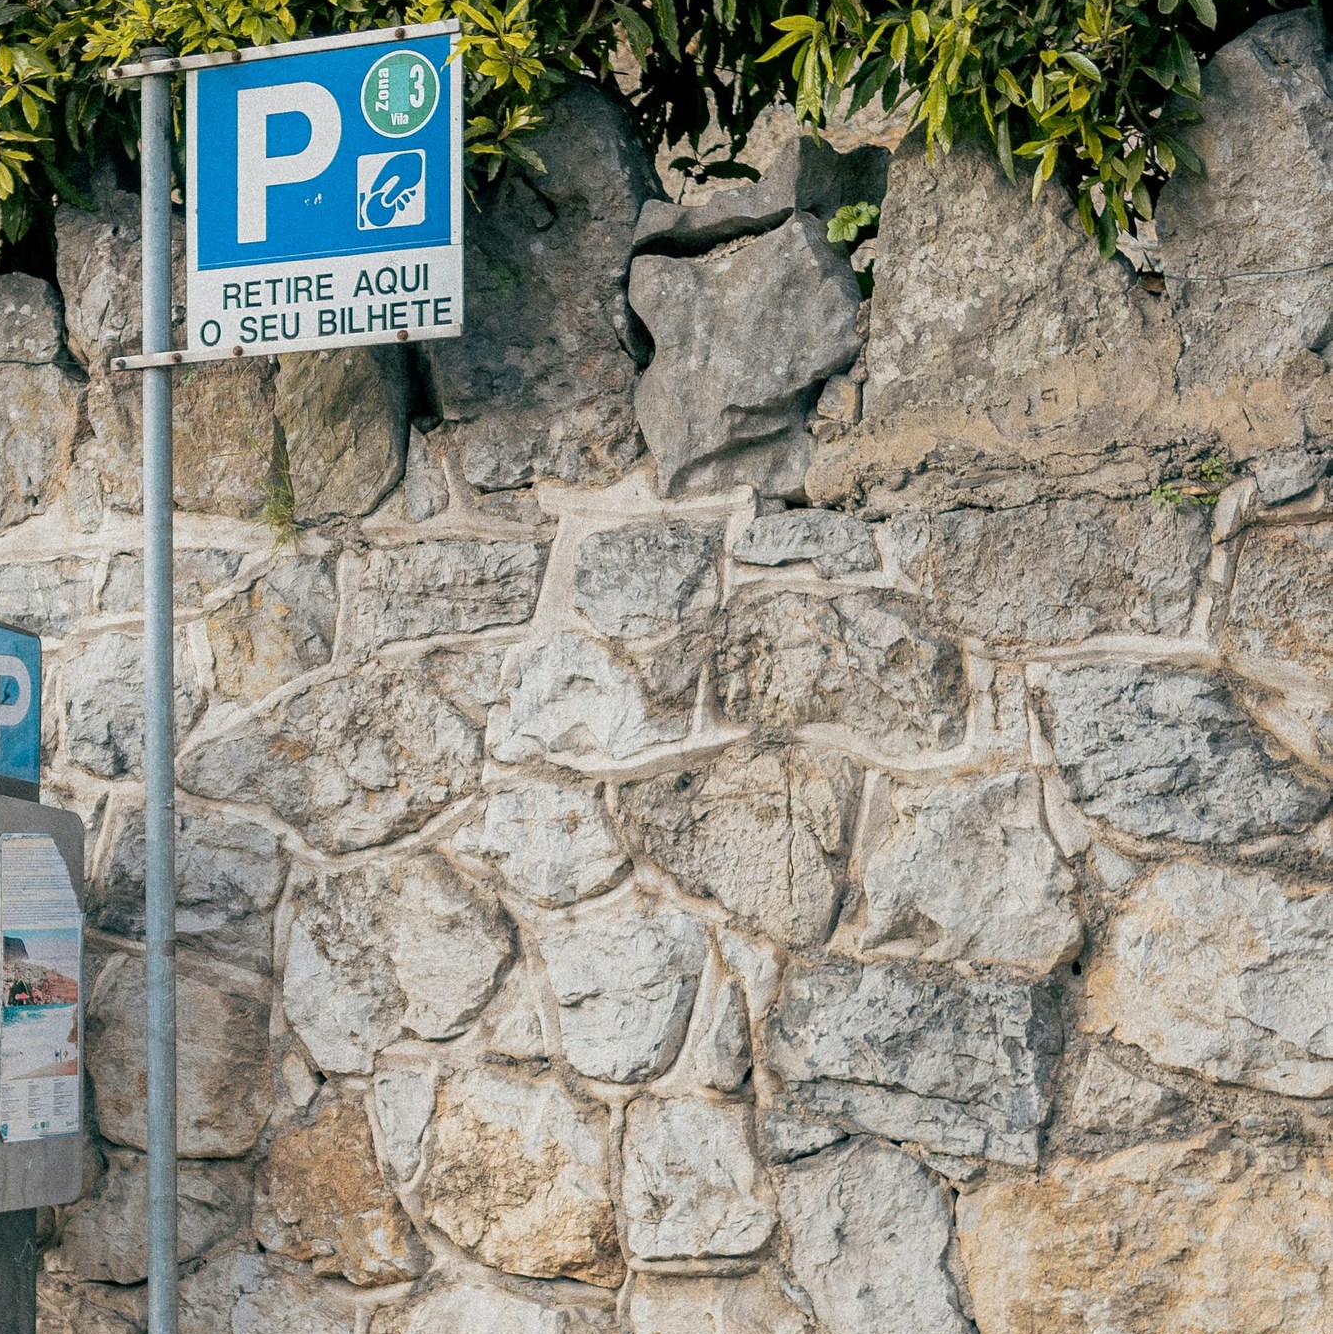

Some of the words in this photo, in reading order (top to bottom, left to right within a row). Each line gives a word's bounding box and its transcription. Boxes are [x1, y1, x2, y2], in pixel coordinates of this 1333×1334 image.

[375, 67, 389, 112] Zona
[409, 64, 425, 108] 3
[390, 112, 410, 126] Vila
[237, 81, 342, 244] P
[222, 273, 334, 310] RETIRE
[353, 263, 429, 298] AQUI
[199, 319, 222, 347] O
[240, 312, 300, 344] SEU
[318, 296, 453, 337] BILHETE
